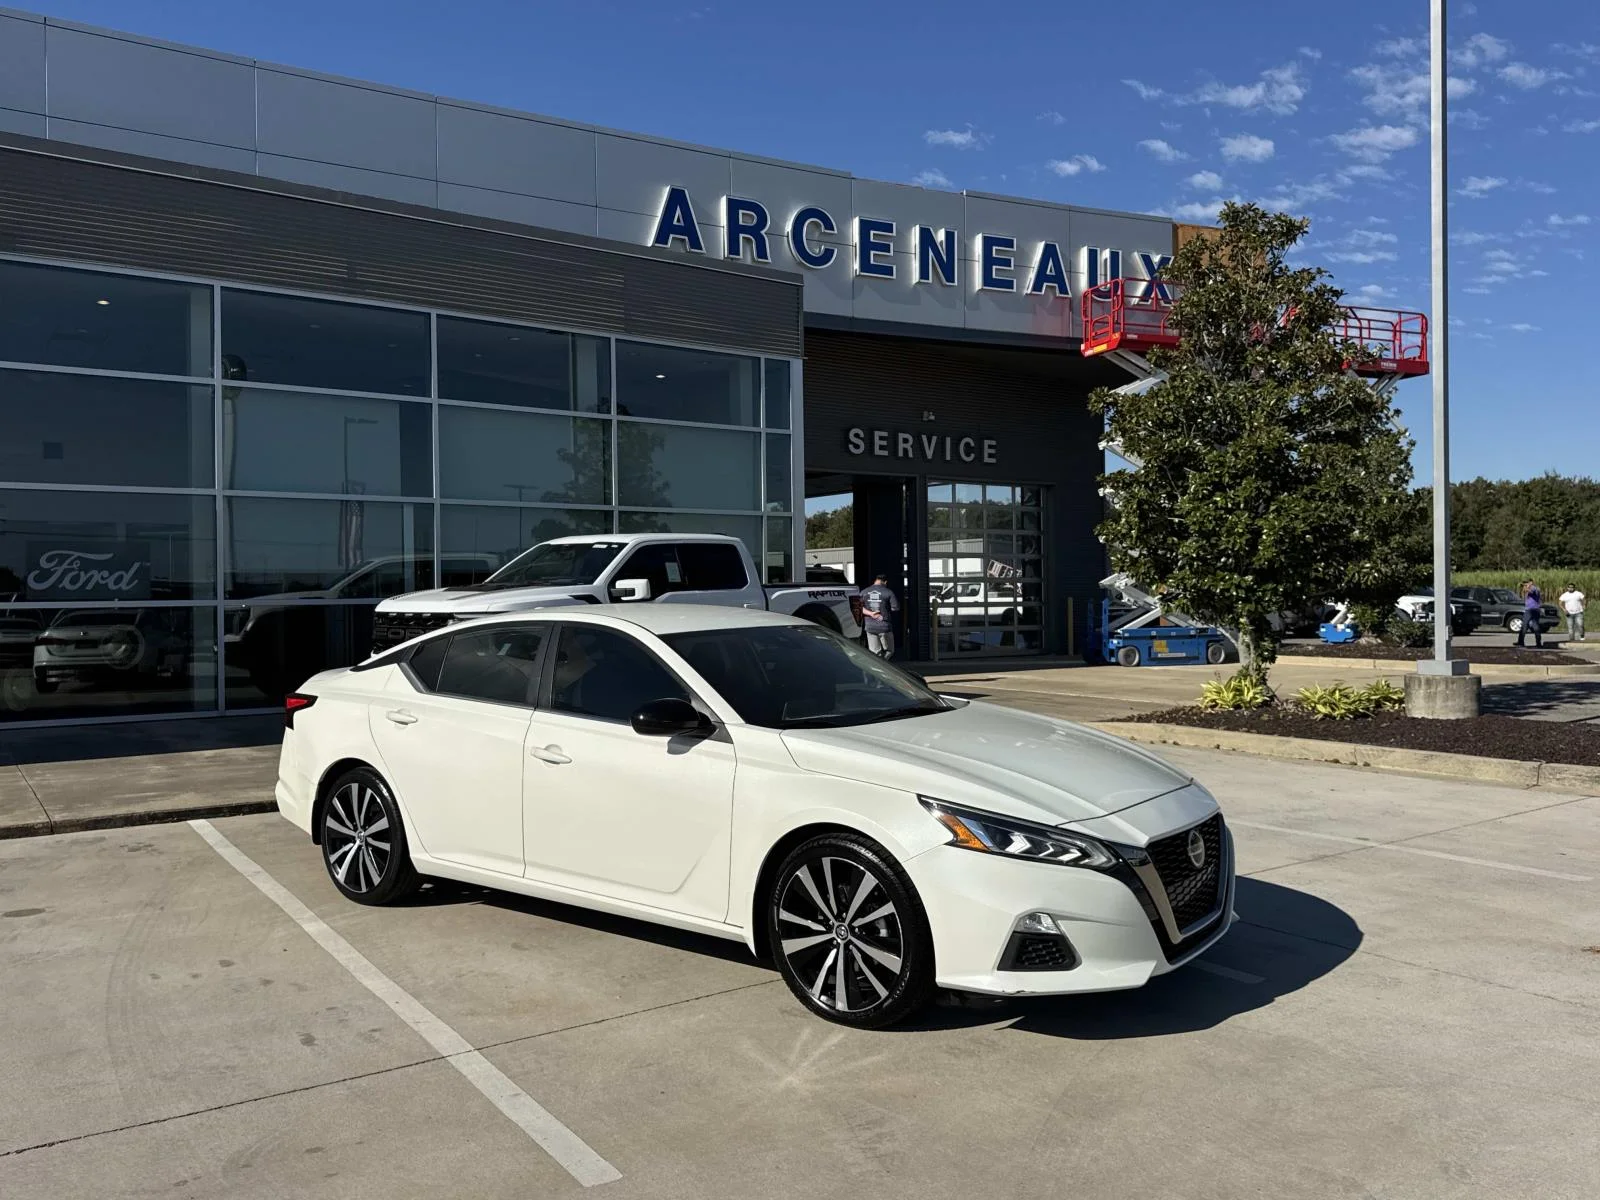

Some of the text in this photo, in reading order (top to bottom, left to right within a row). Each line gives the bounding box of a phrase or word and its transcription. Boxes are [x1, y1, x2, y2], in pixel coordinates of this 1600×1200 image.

[649, 184, 1175, 307] ARCENEAUX
[848, 427, 997, 463] SERVICE
[27, 550, 141, 591] Ford
[808, 590, 847, 600] RAPTOR
[374, 627, 438, 641] FOR
